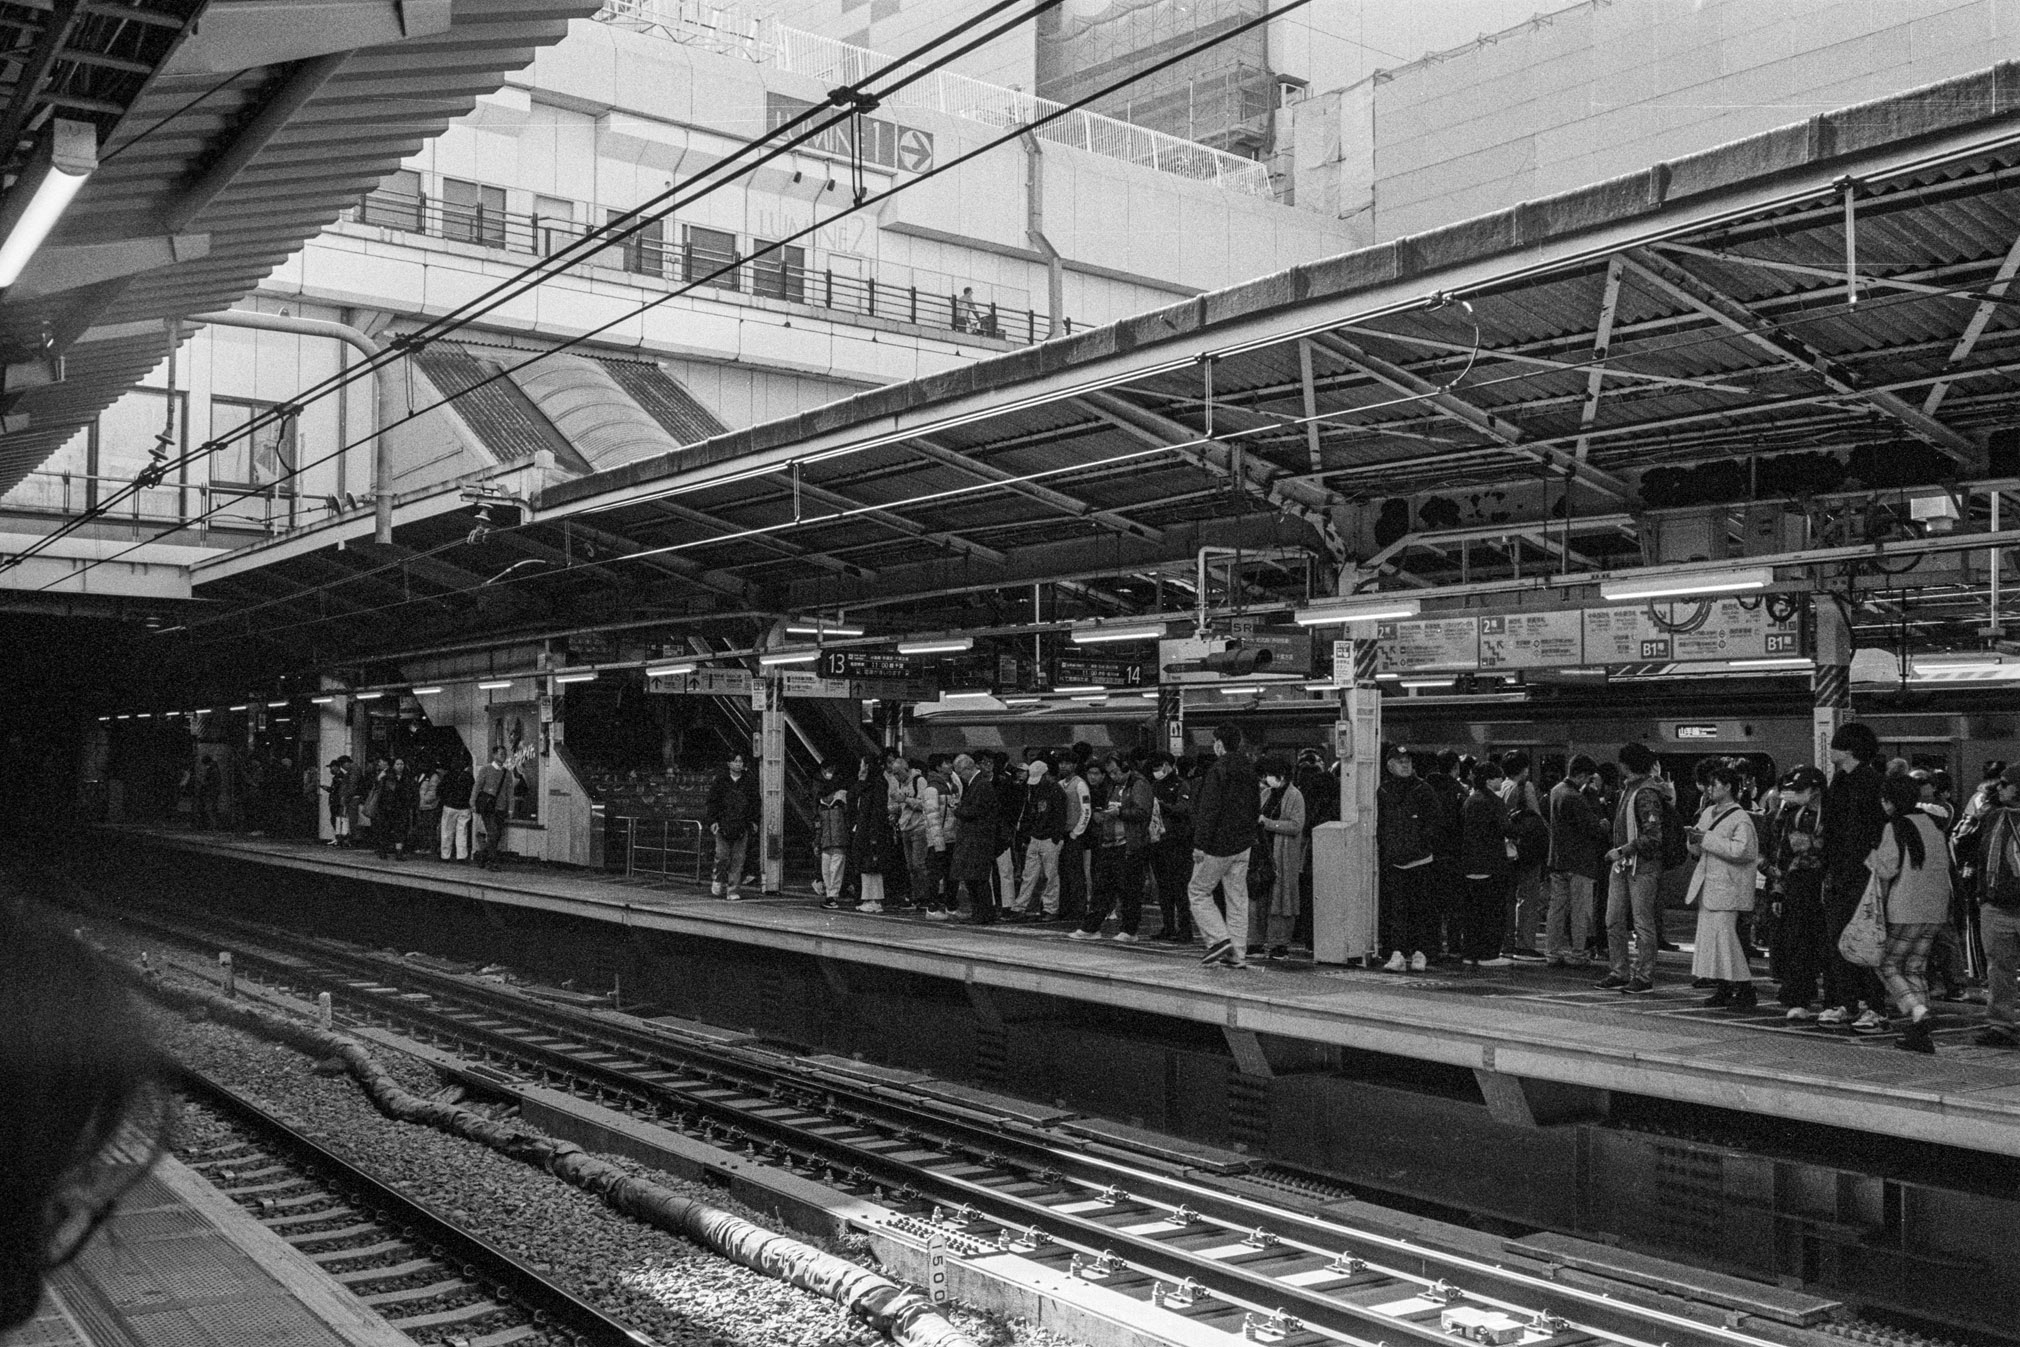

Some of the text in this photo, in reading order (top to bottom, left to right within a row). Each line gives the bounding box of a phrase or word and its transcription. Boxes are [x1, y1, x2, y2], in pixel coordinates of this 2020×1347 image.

[828, 653, 845, 674] 13
[1126, 665, 1141, 684] 14
[931, 1244, 945, 1302] 1500
